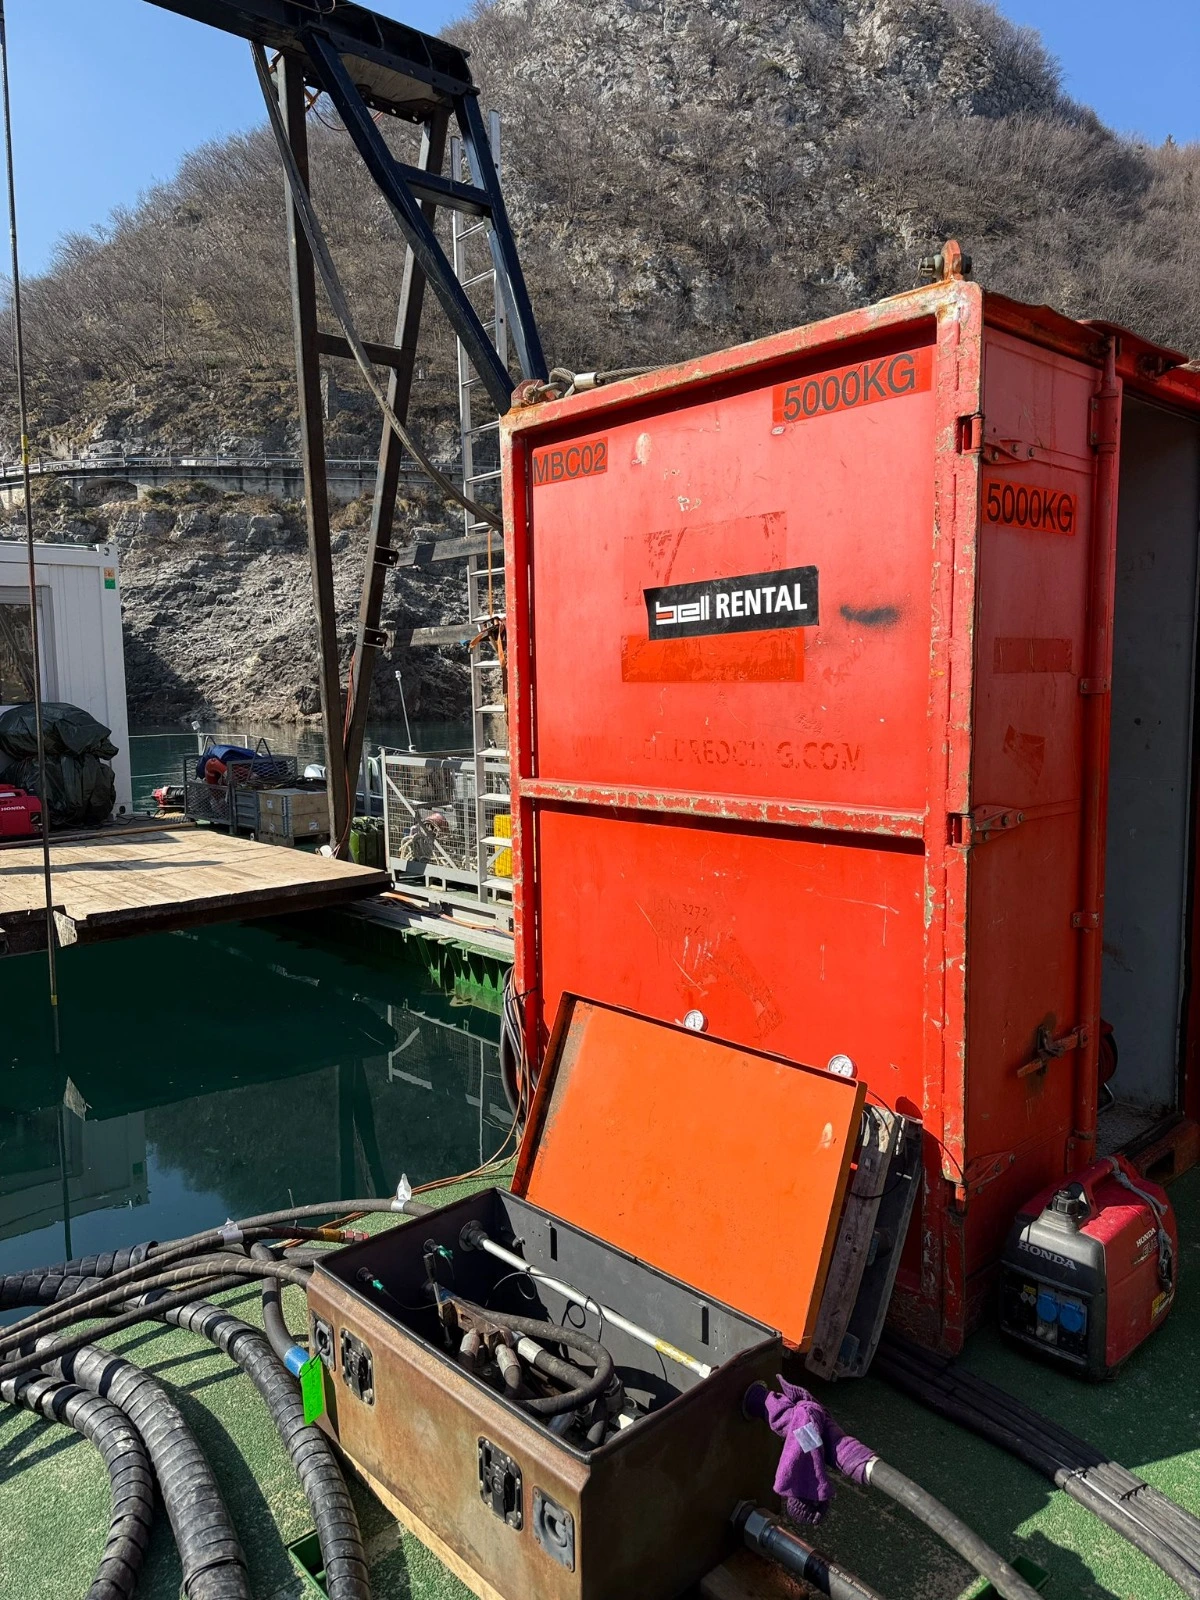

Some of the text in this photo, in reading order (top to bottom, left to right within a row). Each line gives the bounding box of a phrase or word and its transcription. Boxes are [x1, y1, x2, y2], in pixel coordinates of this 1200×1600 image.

[783, 353, 915, 421] 5000KG
[533, 442, 606, 484] MBC02
[987, 482, 1073, 533] 5000KG
[655, 583, 808, 626] bell RENTAL
[1017, 1240, 1077, 1271] HONDA
[1136, 1227, 1156, 1248] HONDA
